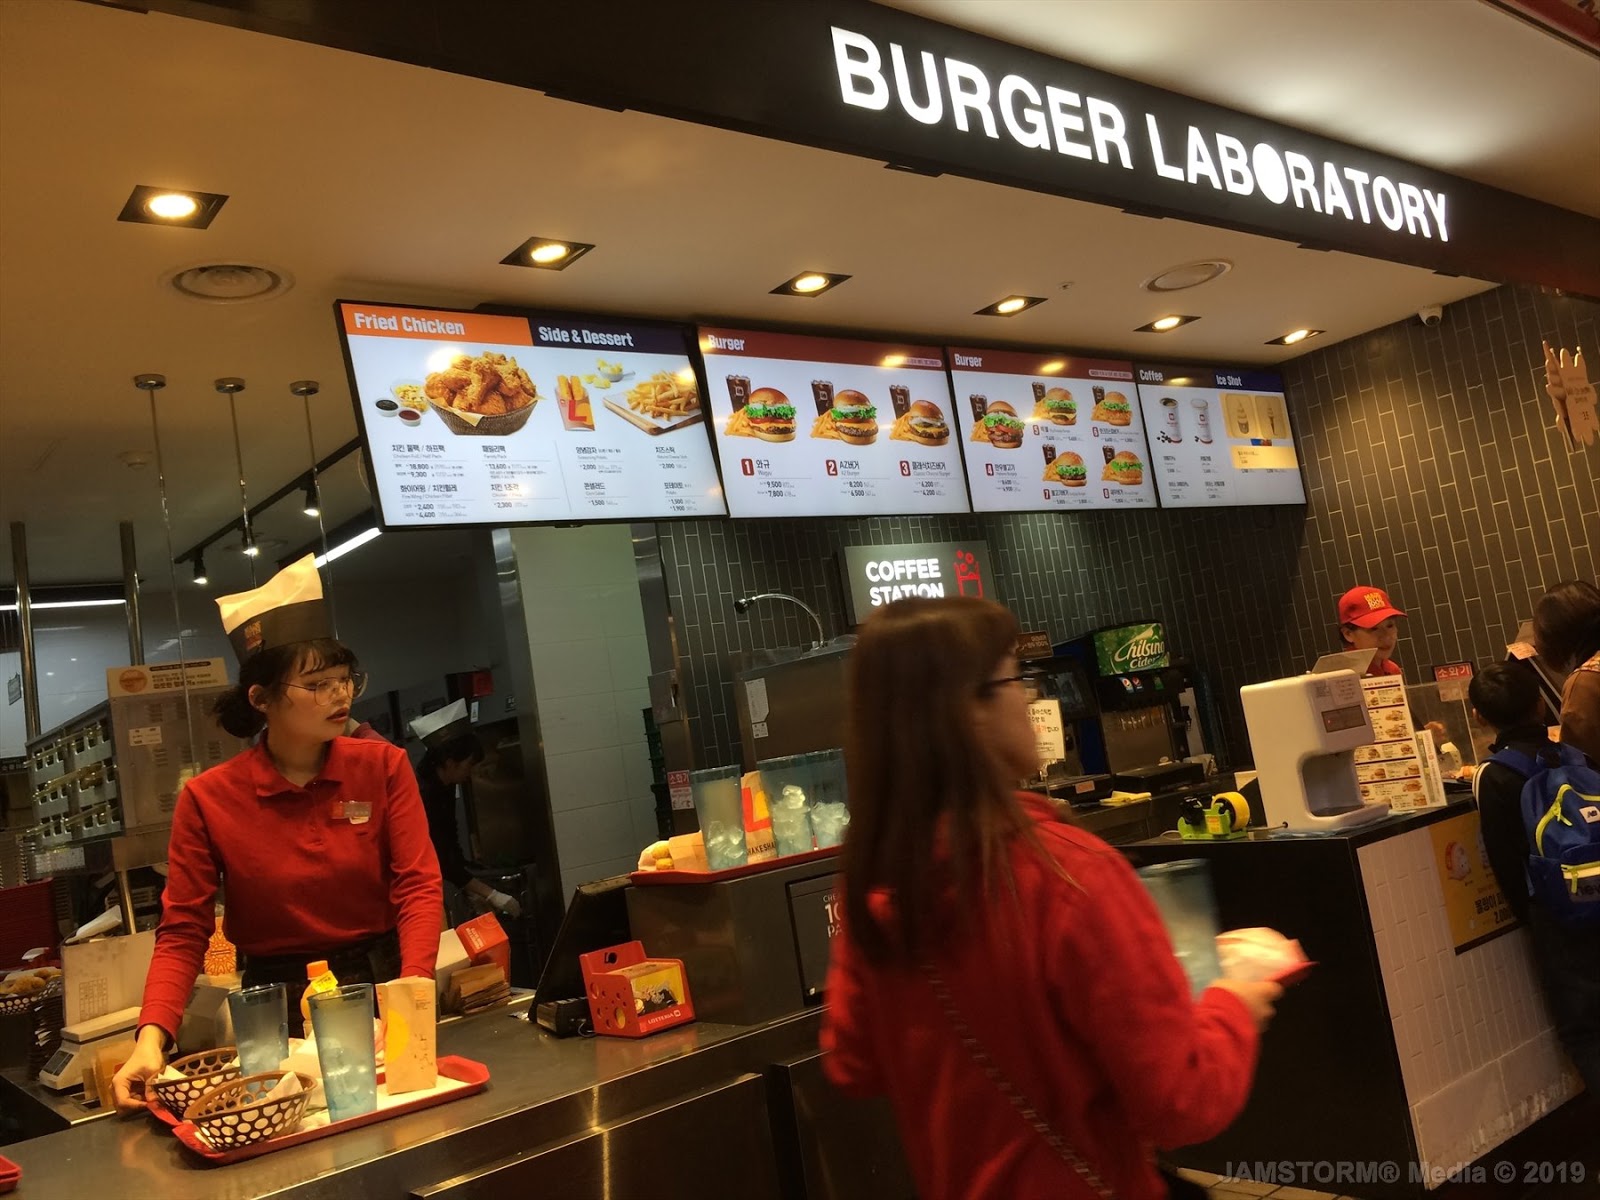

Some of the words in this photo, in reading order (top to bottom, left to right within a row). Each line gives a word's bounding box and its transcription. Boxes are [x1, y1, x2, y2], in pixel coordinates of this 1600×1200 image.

[830, 26, 1133, 170] BURGER
[1144, 112, 1449, 243] LABORATORY
[353, 312, 399, 331] Fried
[402, 316, 465, 335] Chicken
[538, 326, 570, 343] Side
[571, 329, 582, 343] &
[582, 329, 634, 347] Dessert
[708, 334, 745, 351] Burger
[954, 353, 983, 367] Burger
[1139, 369, 1164, 381] Coffee
[1216, 374, 1227, 386] Ice
[1227, 376, 1242, 387] Shot
[756, 459, 770, 469] 와규
[865, 557, 942, 583] COFFEE
[869, 582, 945, 607] STATION
[1129, 656, 1156, 669] Cider
[1438, 664, 1470, 679] 소화기
